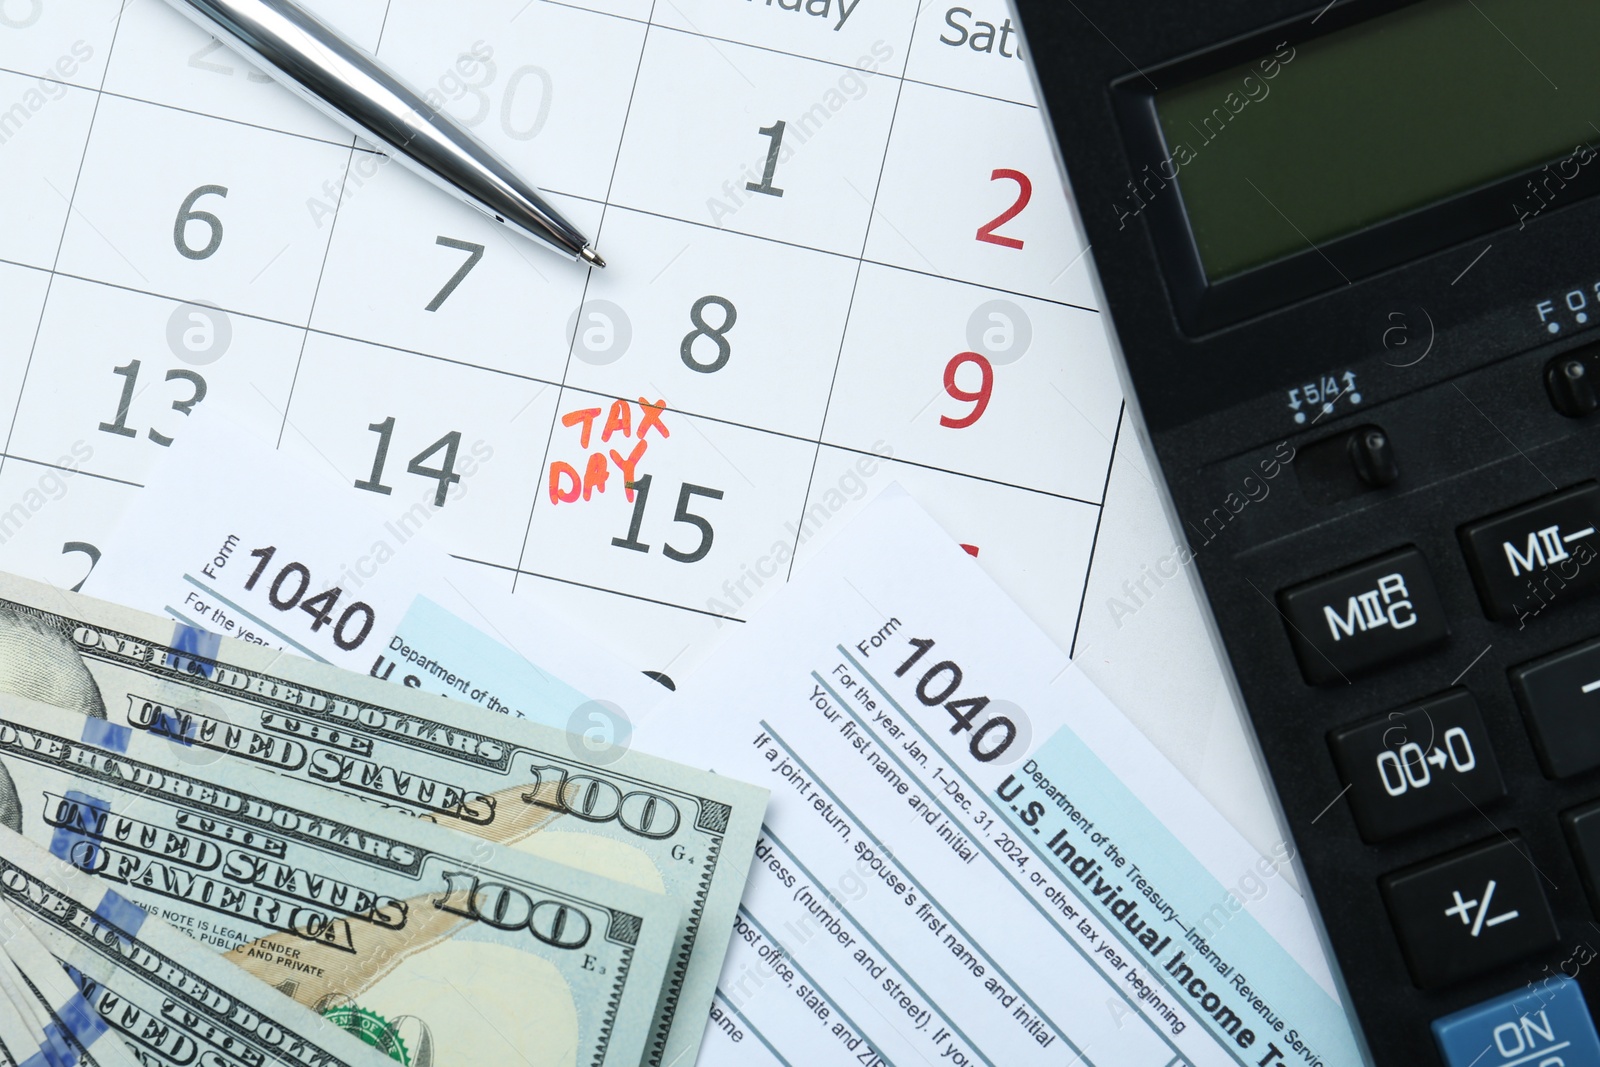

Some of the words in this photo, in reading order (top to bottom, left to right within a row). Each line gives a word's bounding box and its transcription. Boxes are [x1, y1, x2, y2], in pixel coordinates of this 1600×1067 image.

[940, 7, 1023, 61] Sat
[746, 120, 786, 197] 1
[975, 169, 1032, 250] 2
[172, 184, 228, 260] 6
[425, 236, 485, 312] 7
[680, 295, 737, 374] 8
[939, 352, 994, 429] 9
[1536, 301, 1553, 322] F
[562, 397, 670, 449] TAX
[1303, 377, 1340, 405] 5/4
[98, 359, 208, 447] 13
[354, 416, 462, 507] 14
[611, 474, 724, 563] 15
[549, 439, 648, 505] DAY
[201, 534, 240, 580] Form
[244, 546, 375, 651] 1040
[185, 592, 211, 612] For
[215, 609, 235, 630] the
[856, 616, 902, 658] Form
[73, 627, 147, 663] ONE
[149, 646, 328, 713] HUNDRED
[329, 700, 505, 763] DOLLARS
[389, 635, 471, 694] Department
[470, 688, 489, 703] of
[894, 636, 1016, 763] 1040
[127, 693, 307, 771] UNITED
[308, 748, 497, 826] STATES
[261, 710, 374, 757] THE
[809, 685, 842, 723] Your
[840, 720, 872, 754] first
[867, 752, 909, 795] name
[907, 794, 941, 826] and
[936, 820, 979, 864] initial
[68, 748, 243, 814] HUNDRED
[244, 802, 417, 866] DOLLARS
[176, 810, 287, 859] THE
[521, 765, 681, 840] 100
[832, 663, 857, 689] For
[854, 686, 876, 711] the
[872, 710, 905, 740] year
[903, 741, 928, 769] Jan.
[974, 811, 995, 837] 31,
[994, 833, 1029, 873] 2024,
[1030, 871, 1047, 887] or
[1045, 886, 1079, 920] other
[1076, 918, 1099, 942] tax
[1095, 941, 1128, 971] year
[1125, 968, 1186, 1034] beginning
[43, 791, 222, 871] UNITED
[222, 850, 408, 930] STATES
[71, 841, 141, 885] OF
[131, 861, 357, 954] AMERICA
[753, 732, 771, 749] If
[765, 748, 778, 762] a
[772, 757, 811, 794] joint
[807, 790, 850, 843] return,
[854, 840, 917, 906] spouse's
[915, 902, 947, 936] first
[943, 933, 985, 978] name
[984, 976, 1018, 1008] and
[1012, 1003, 1056, 1048] initial
[1, 868, 71, 920] ONE
[69, 908, 232, 1015] HUNDRED
[162, 909, 194, 926] NOTE
[198, 919, 209, 931] IS
[212, 925, 250, 943] LEGAL
[253, 937, 301, 959] TENDER
[200, 932, 244, 953] PUBLIC
[247, 947, 273, 963] AND
[276, 956, 325, 978] PRIVATE
[433, 871, 592, 950] 100
[755, 838, 796, 888] ddress
[792, 885, 856, 949] (number
[853, 948, 887, 980] and
[882, 977, 932, 1032] street).
[931, 1027, 951, 1045] If
[995, 774, 1045, 836] U.S.
[1046, 828, 1172, 958] Individual
[1164, 951, 1256, 1049] Income
[1022, 759, 1095, 834] Department
[1091, 832, 1109, 847] of
[1104, 844, 1126, 868] the
[1230, 973, 1284, 1032] Revenue
[1283, 1029, 1324, 1067] Servic
[361, 1018, 379, 1034] OF
[710, 1002, 743, 1043] ame
[758, 944, 794, 988] office,
[796, 984, 829, 1026] state,
[831, 1022, 863, 1051] and
[1493, 1010, 1556, 1058] ON
